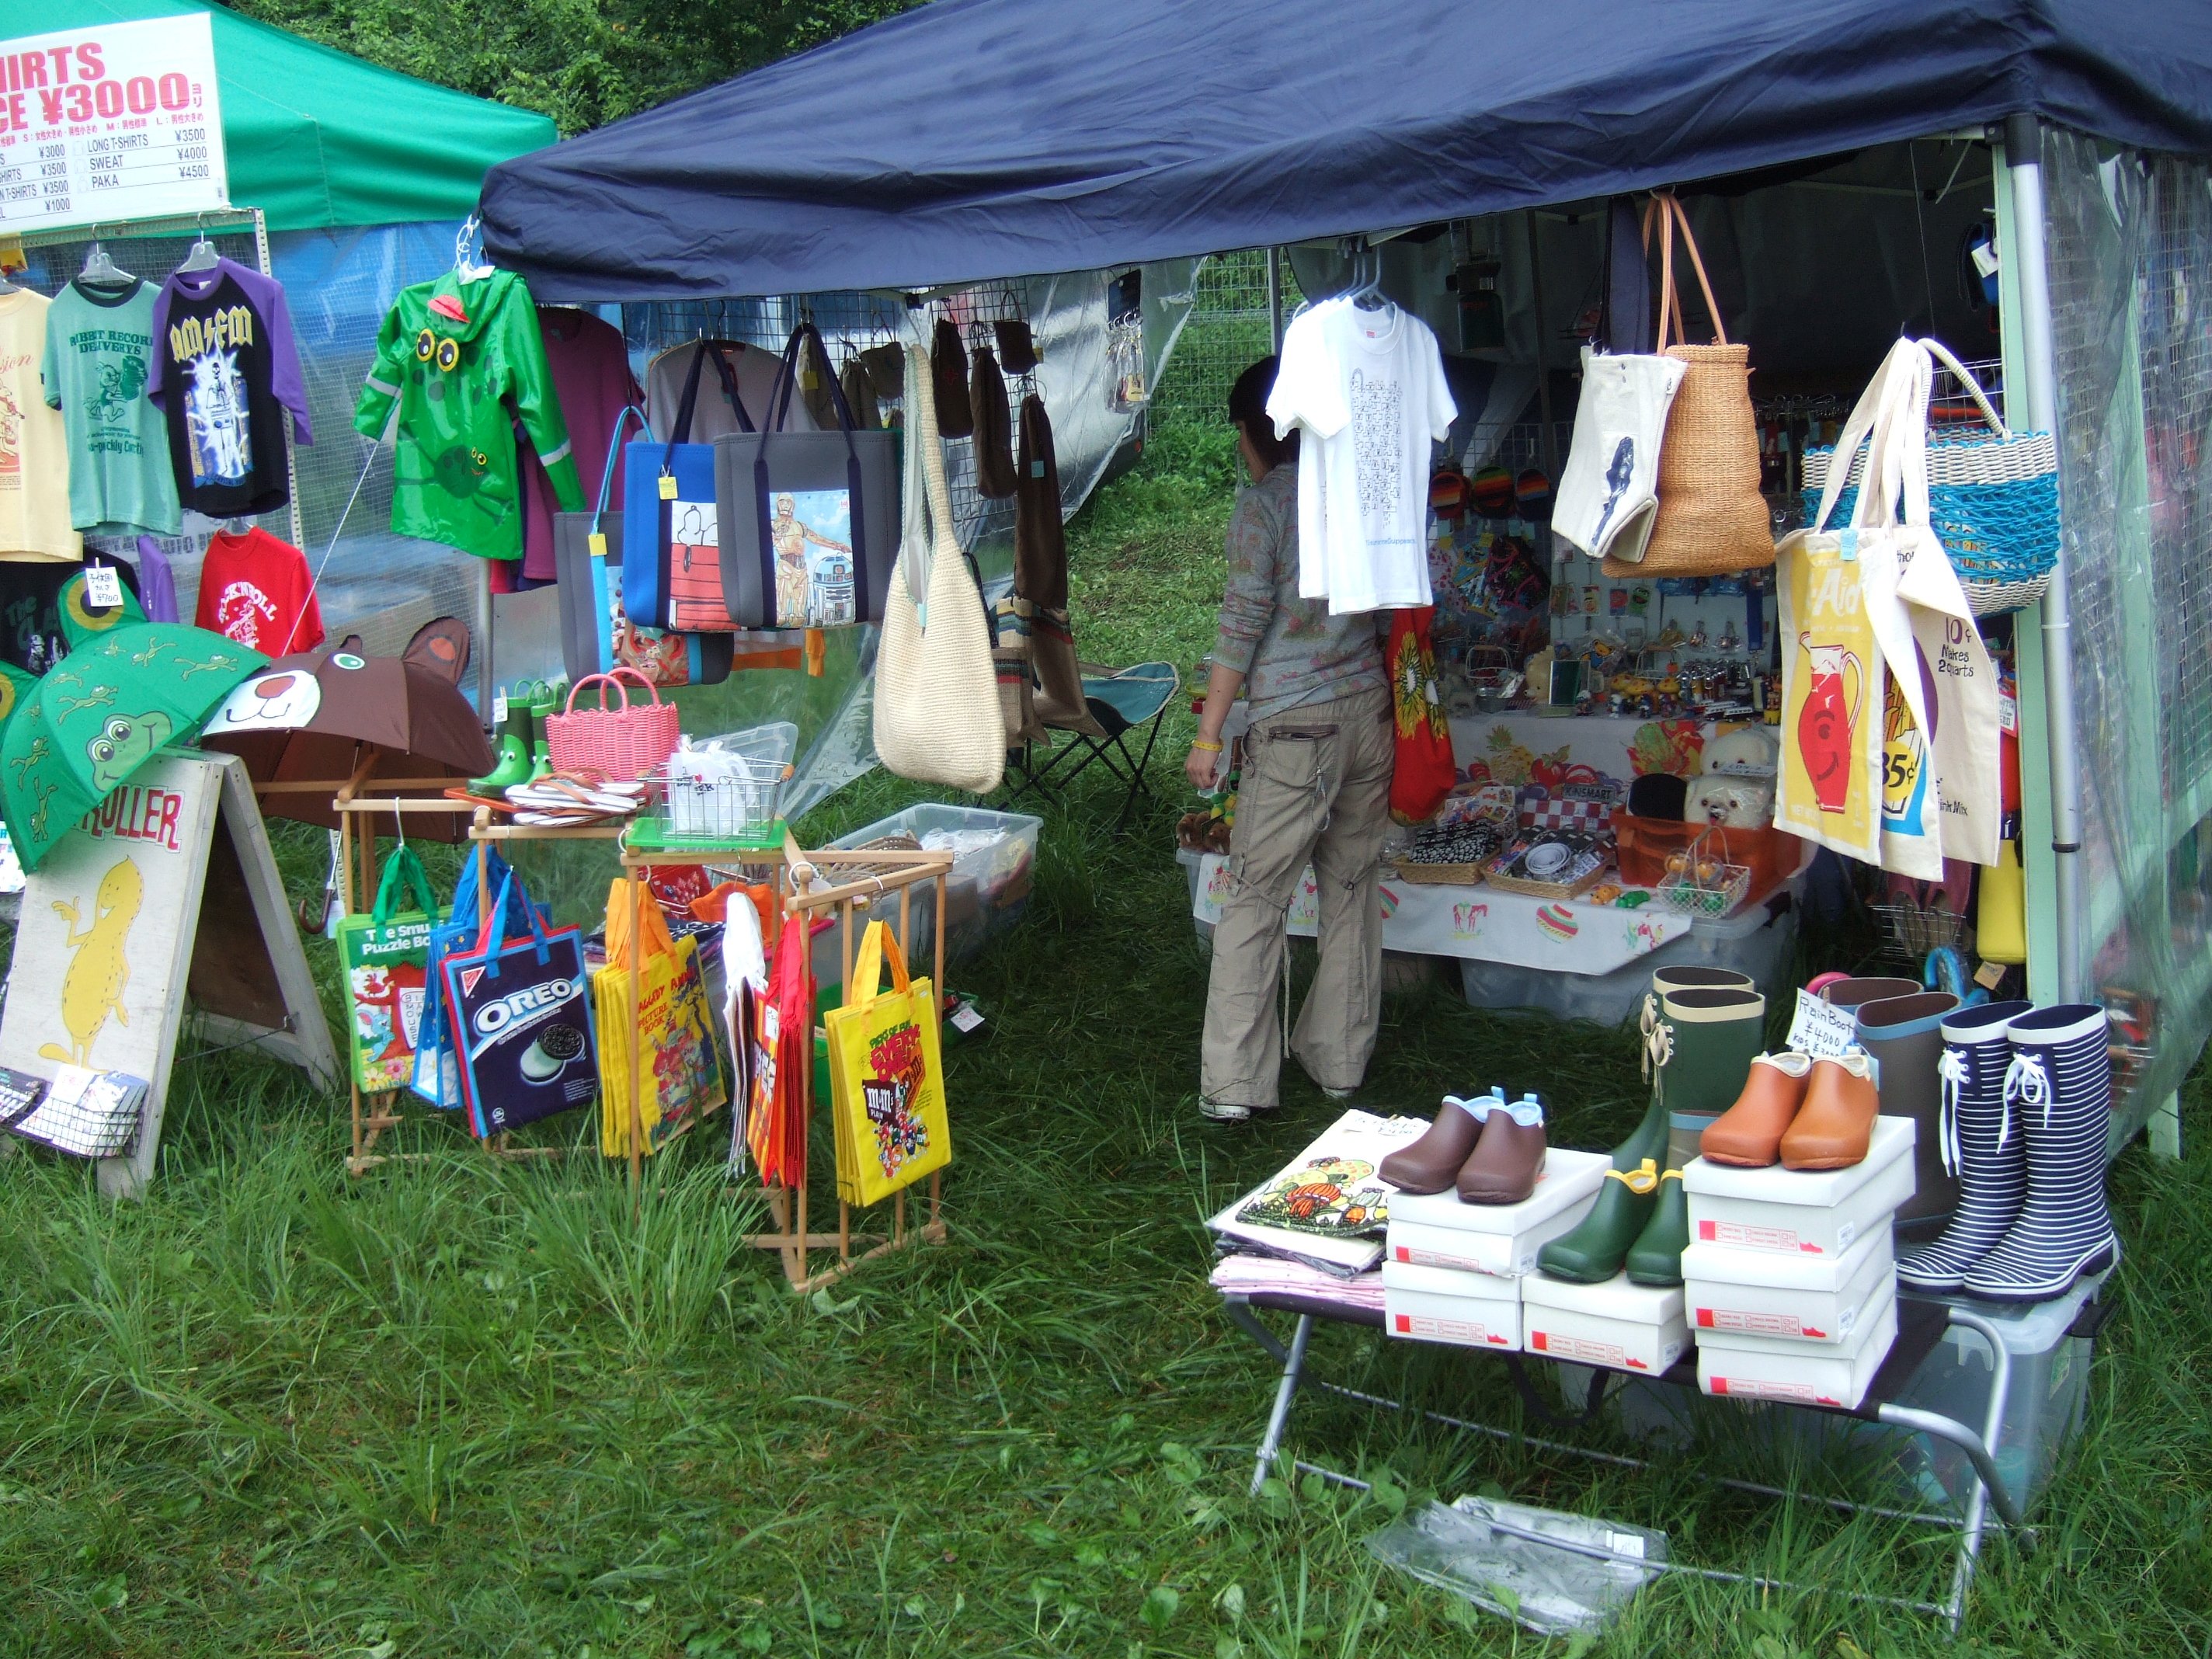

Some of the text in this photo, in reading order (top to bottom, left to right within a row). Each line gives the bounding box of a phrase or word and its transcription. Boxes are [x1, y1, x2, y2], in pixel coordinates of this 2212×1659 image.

[39, 72, 190, 126] ¥3000
[39, 144, 65, 158] ¥3000
[87, 128, 206, 153] LONG T-SHIRTS ¥3500
[40, 162, 67, 176] ¥3500
[89, 146, 207, 170] SWEAT ¥4000
[43, 179, 69, 194] ¥3500
[92, 164, 210, 189] PAKA ¥4500
[45, 197, 71, 212] ¥1000
[1941, 643, 1970, 662] Makes
[362, 935, 431, 955] Puzzle Bo
[476, 979, 572, 1033] OREO
[1799, 996, 1855, 1035] Rain Boot
[1804, 1019, 1840, 1047] ¥4000
